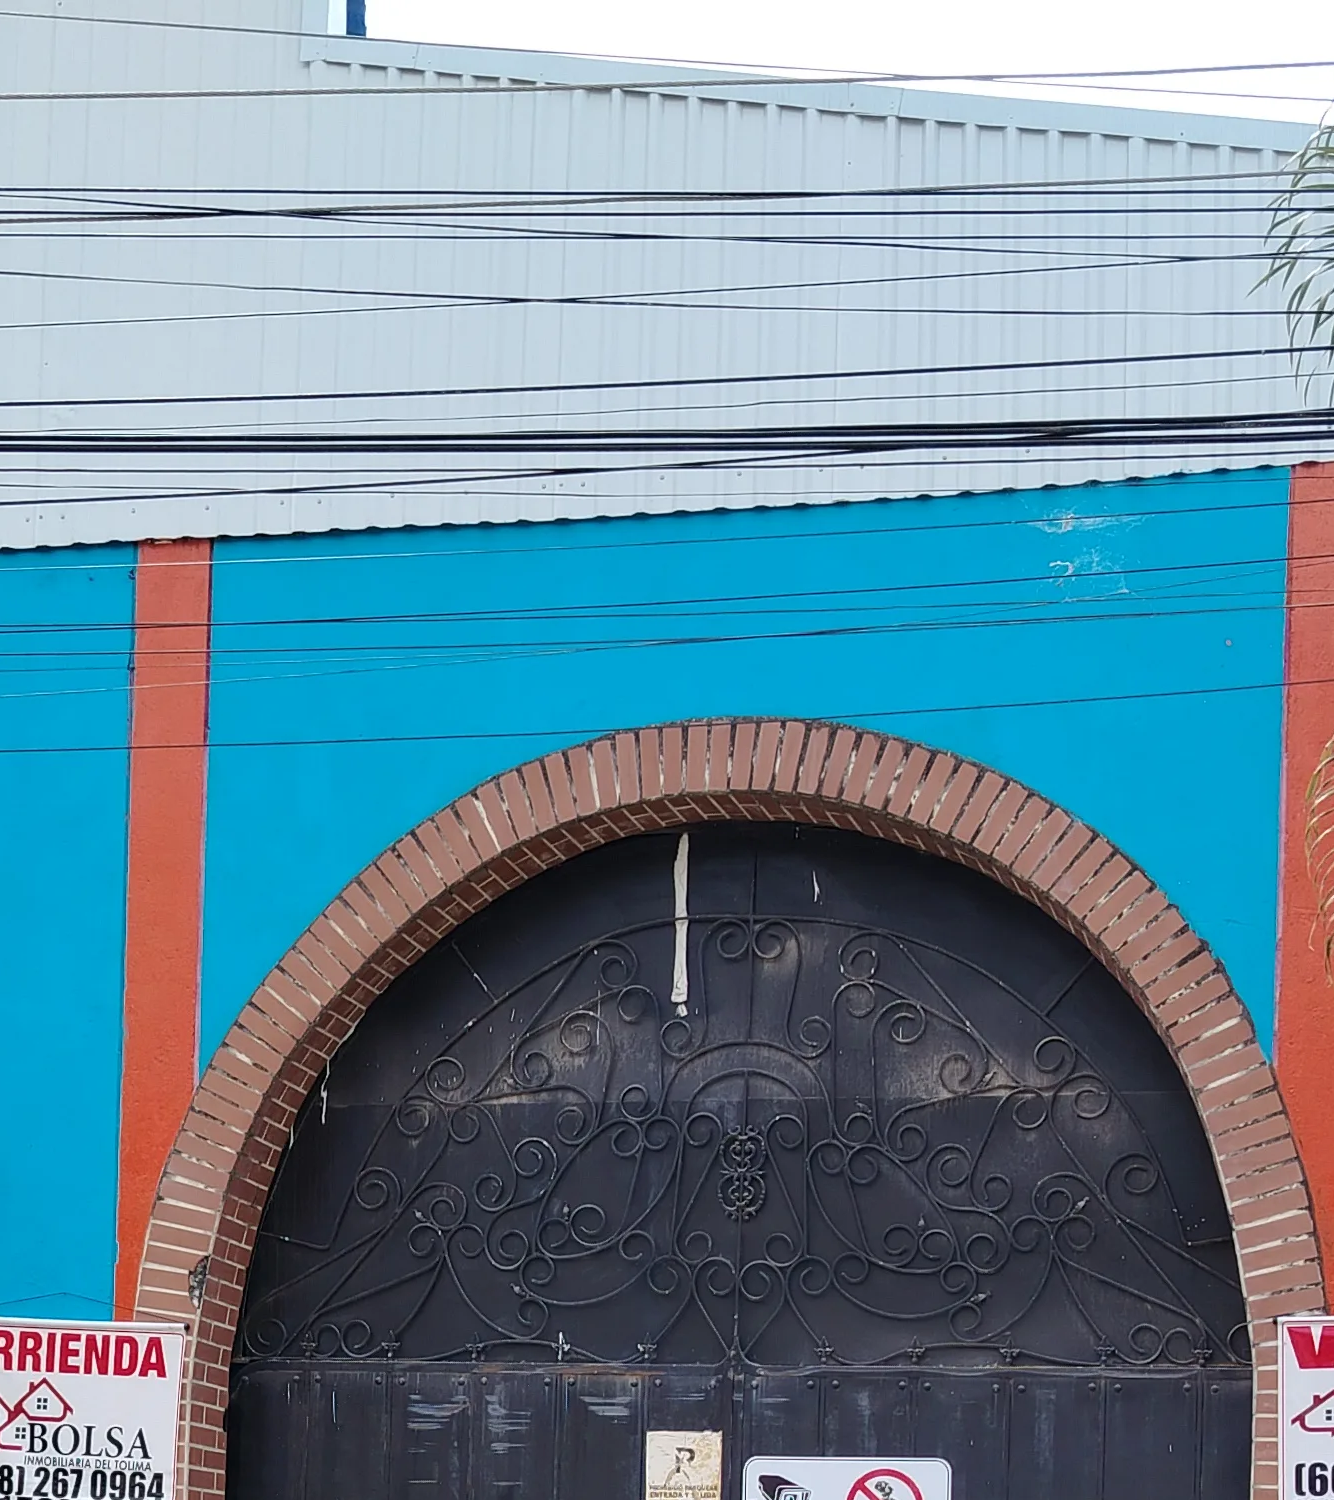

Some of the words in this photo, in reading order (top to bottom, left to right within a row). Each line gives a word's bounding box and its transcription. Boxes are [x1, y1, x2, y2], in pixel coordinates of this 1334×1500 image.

[26, 1422, 152, 1460] BOLSA
[24, 1455, 91, 1469] INMOBILIARIA
[95, 1459, 111, 1470] DEL
[115, 1460, 152, 1472] TOLIMA
[32, 1467, 84, 1498] 267
